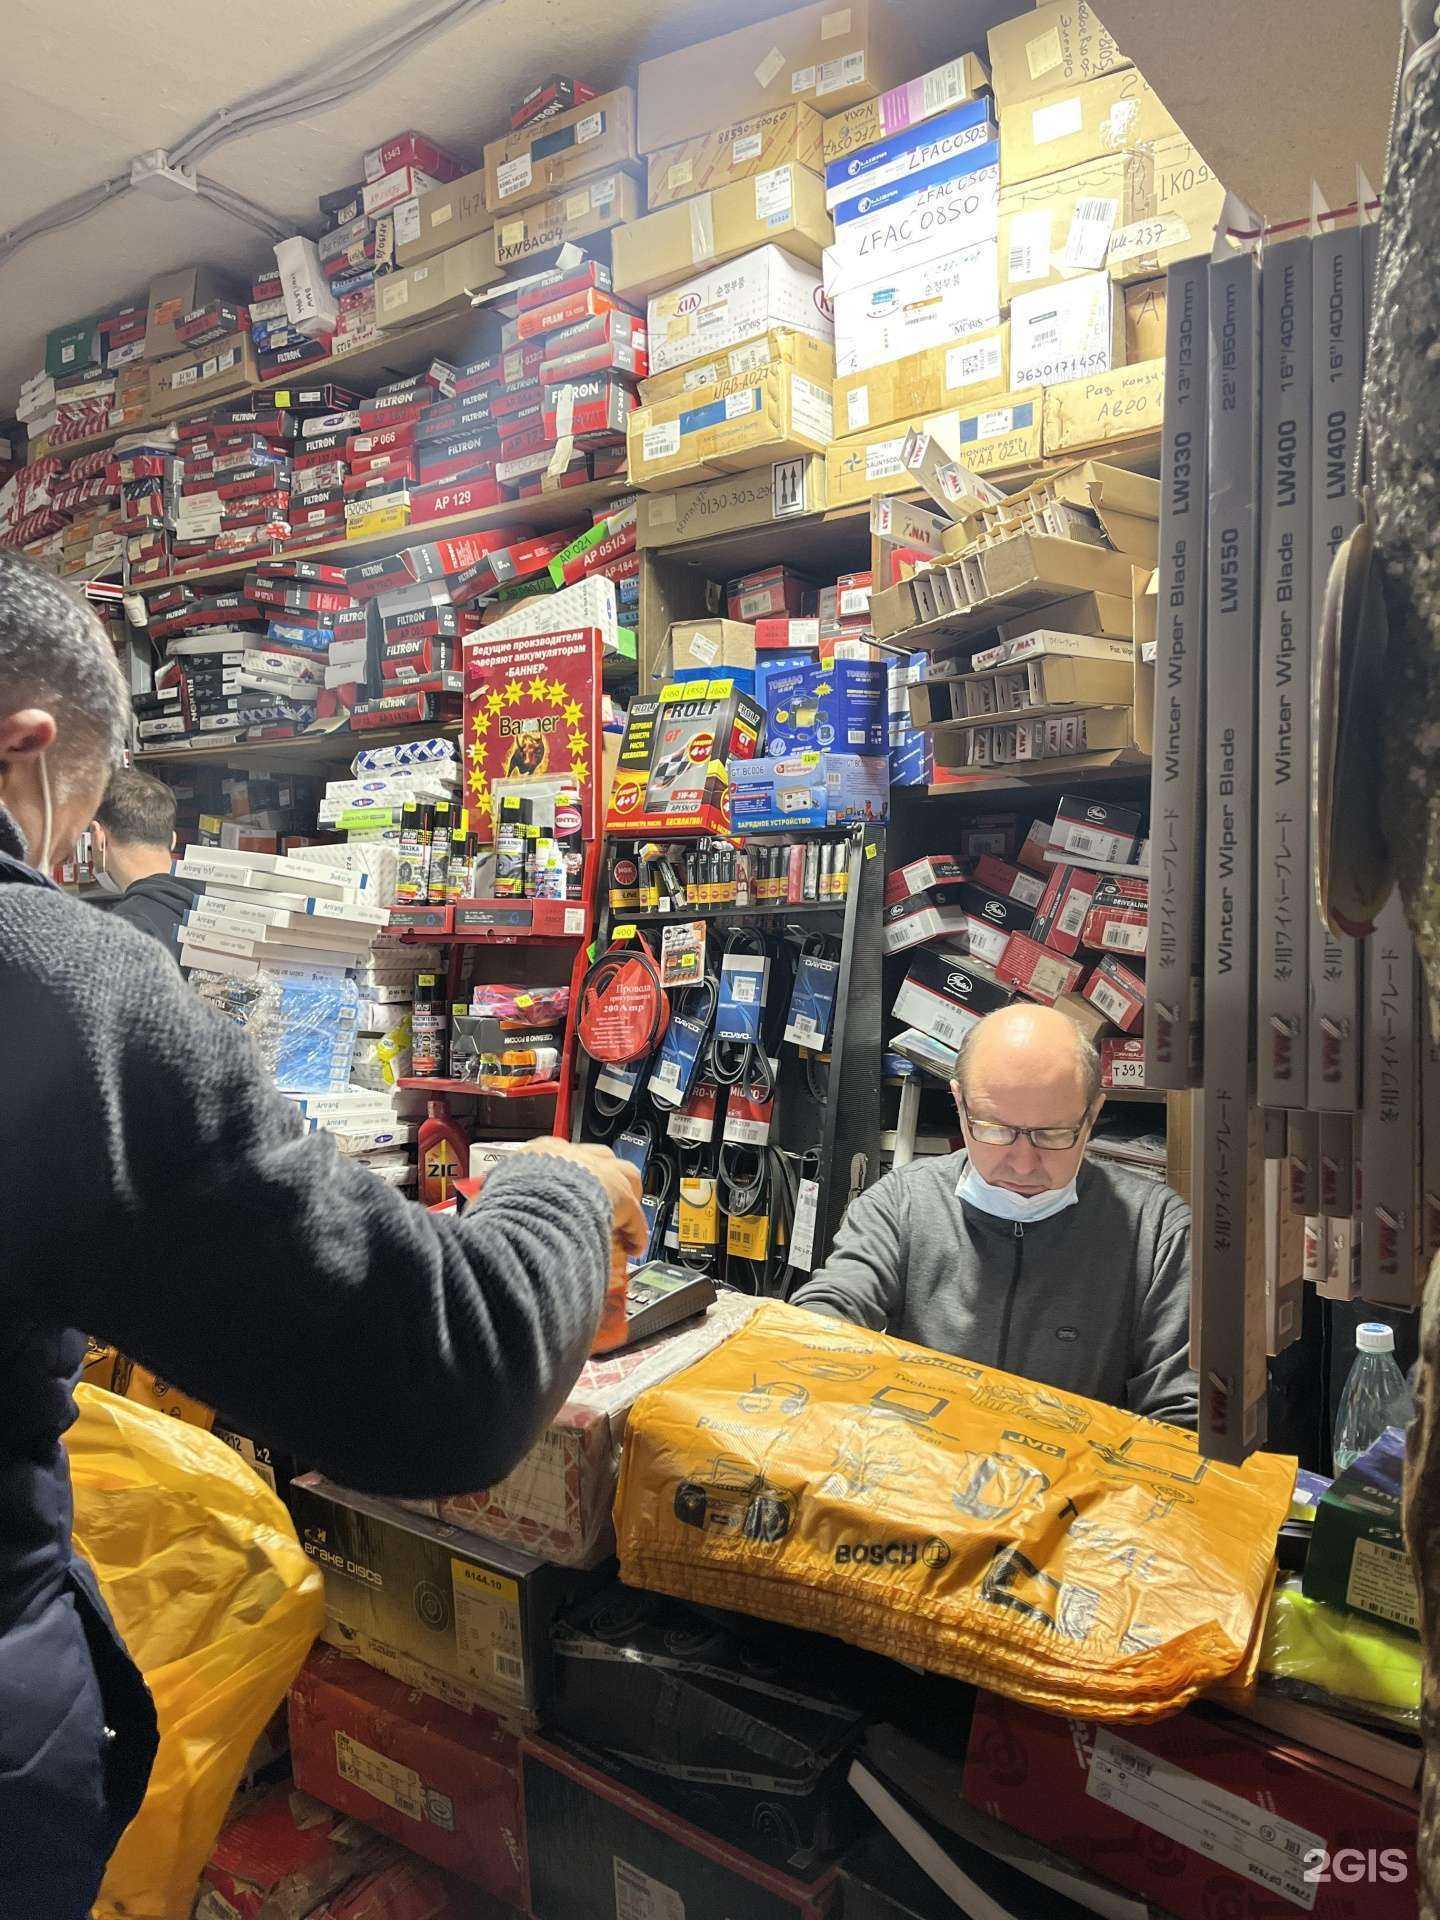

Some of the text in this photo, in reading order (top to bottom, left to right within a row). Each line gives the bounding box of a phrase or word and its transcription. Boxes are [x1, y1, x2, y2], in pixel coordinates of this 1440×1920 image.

[673, 294, 701, 317] KIA
[375, 391, 416, 408] FILTRON
[306, 435, 336, 451] FILTRON
[1327, 410, 1347, 500] LW400
[1172, 432, 1192, 515] LW330
[1277, 419, 1297, 507] LW400
[434, 491, 471, 510] AP 129
[583, 534, 626, 567] AP 051/3
[1220, 528, 1239, 614] LW550
[387, 641, 420, 657] FILTRON
[472, 631, 584, 657] Ведущие производители
[514, 644, 587, 663] аккумуляторам
[1164, 540, 1186, 782] Winter Wiper Blade
[1275, 532, 1294, 785] Winter Wiper Blade
[671, 702, 721, 719] ROLF
[500, 715, 560, 737] Baer
[1217, 728, 1238, 975] Winter Wiper Blade
[427, 1163, 459, 1178] ZIC
[1006, 1431, 1064, 1457] JVC
[835, 1542, 918, 1567] BOSCH
